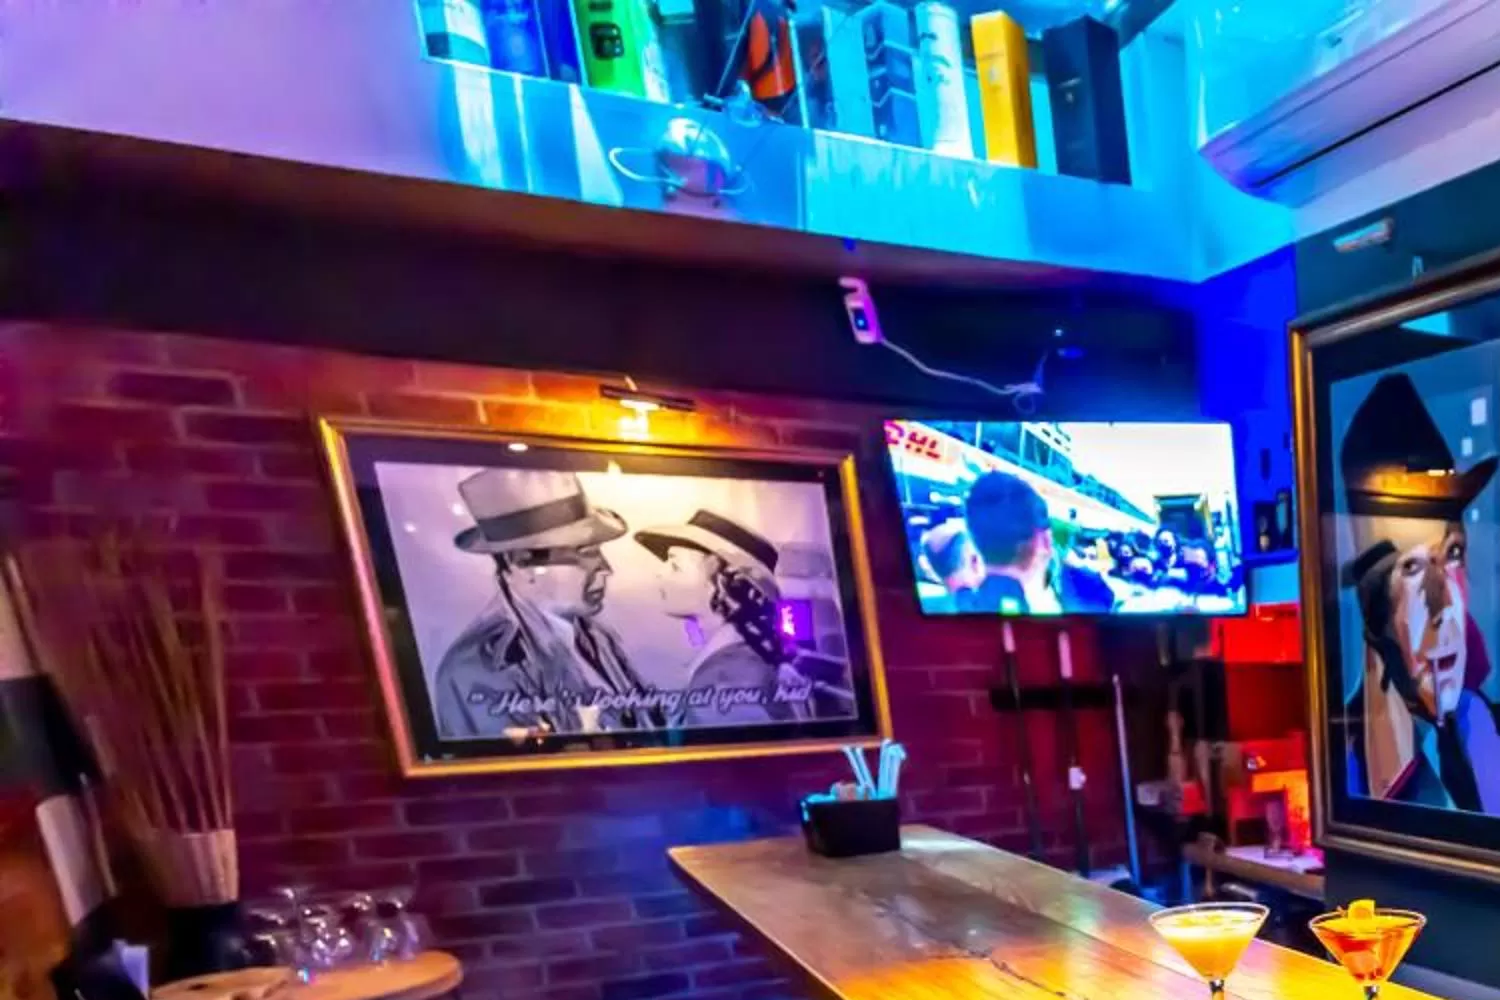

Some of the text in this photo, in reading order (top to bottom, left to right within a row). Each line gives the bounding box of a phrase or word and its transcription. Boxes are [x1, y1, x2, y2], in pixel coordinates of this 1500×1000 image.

[884, 420, 940, 459] DHL
[589, 686, 681, 717] looking
[688, 685, 714, 706] at
